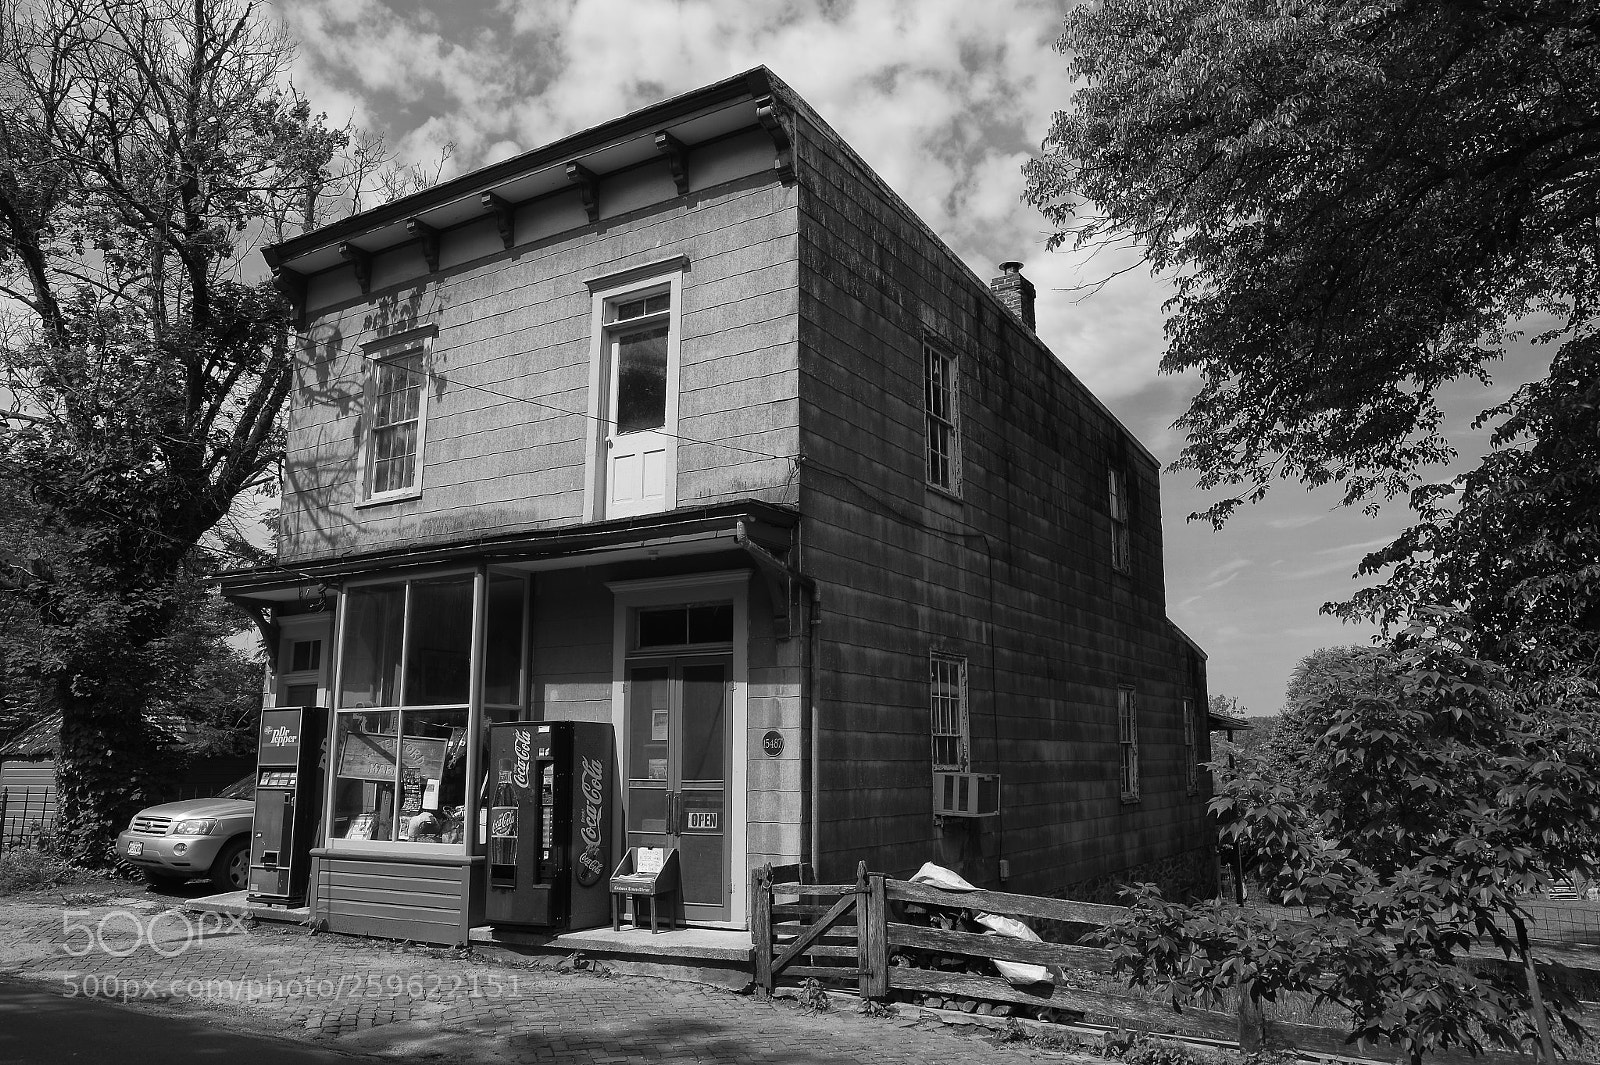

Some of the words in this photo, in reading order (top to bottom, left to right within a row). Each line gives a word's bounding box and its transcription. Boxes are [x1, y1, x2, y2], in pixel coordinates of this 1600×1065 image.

[270, 729, 297, 747] Pepper
[280, 726, 290, 737] Dr
[581, 755, 603, 846] Coca-Cola
[691, 813, 717, 827] OPEN
